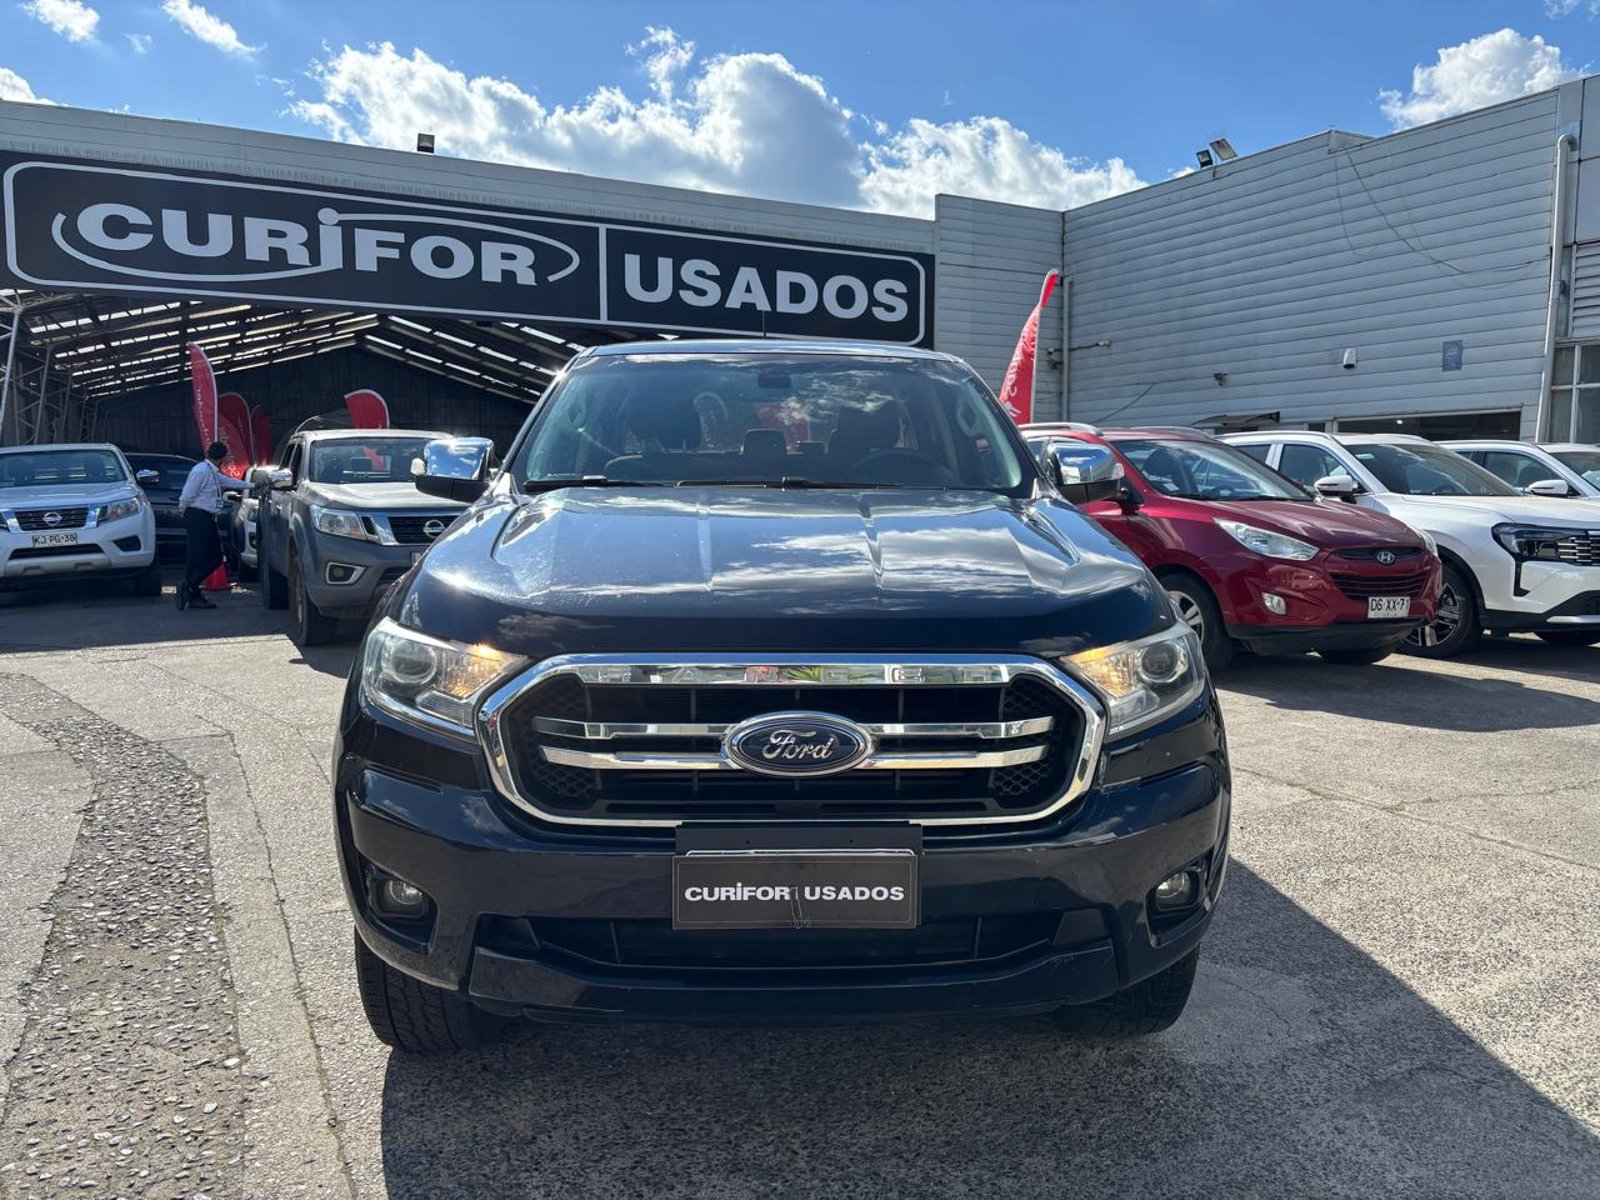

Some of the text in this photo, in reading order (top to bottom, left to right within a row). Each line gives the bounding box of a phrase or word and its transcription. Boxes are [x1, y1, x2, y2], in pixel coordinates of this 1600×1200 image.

[623, 253, 909, 322] USADOS
[762, 729, 835, 759] Ford
[804, 886, 905, 901] USADOS
